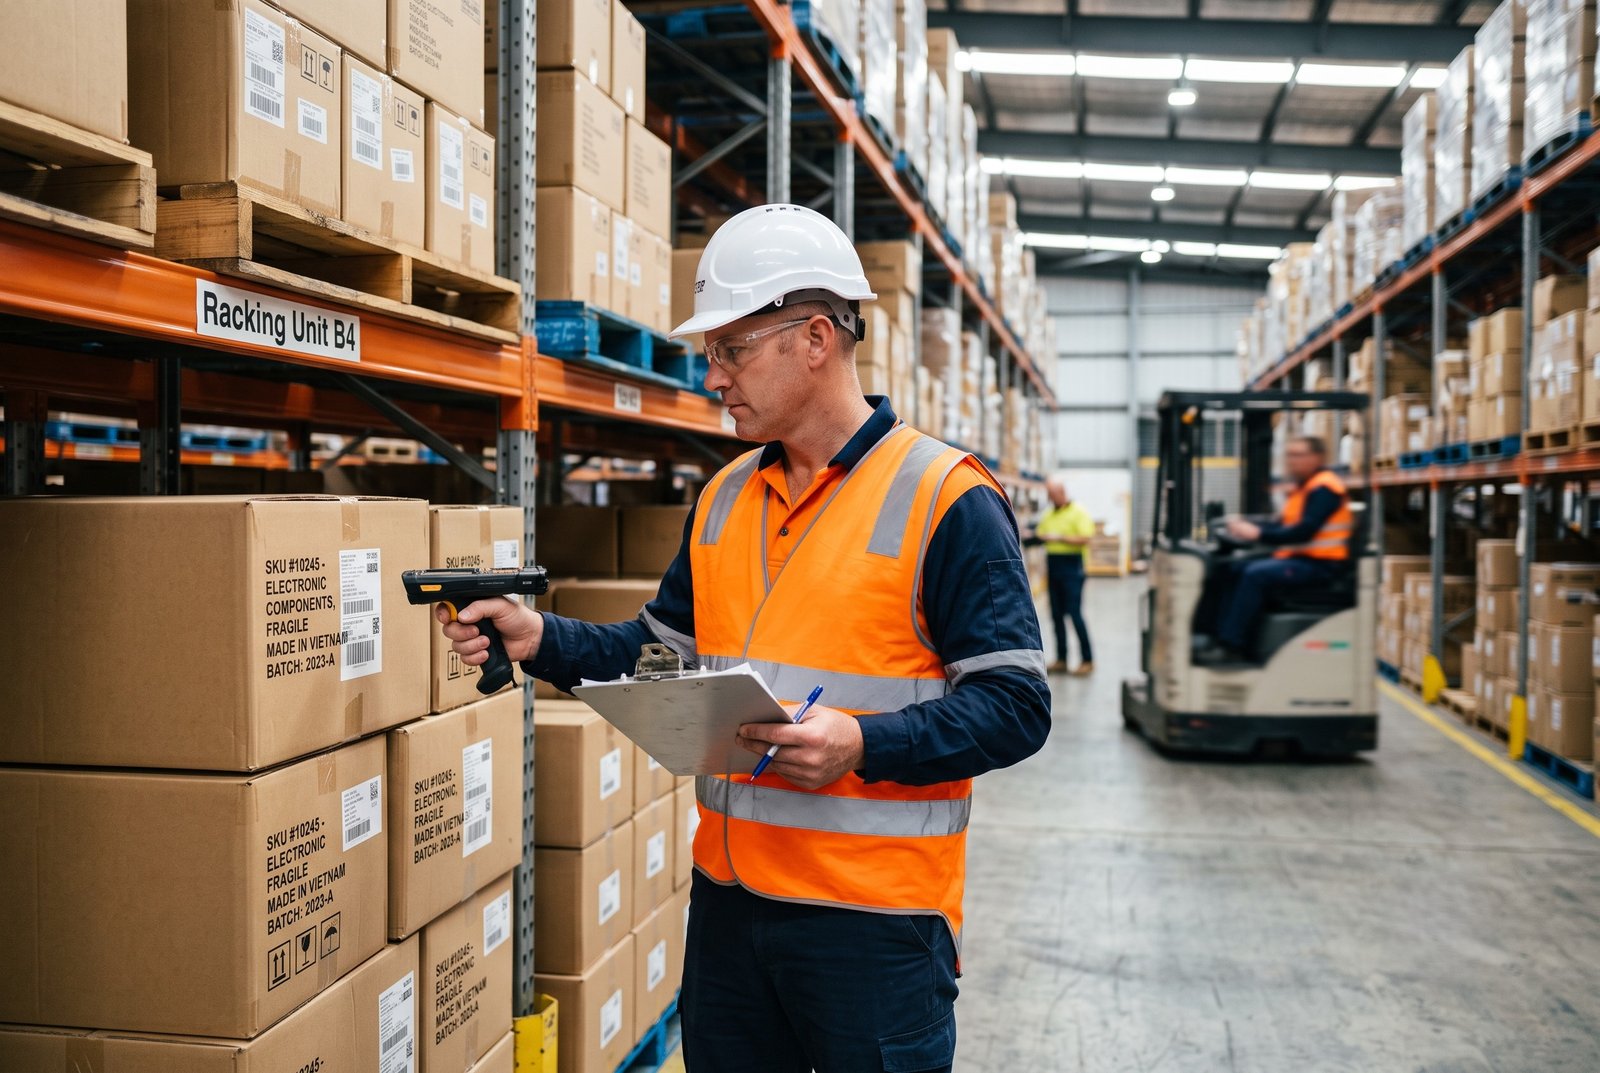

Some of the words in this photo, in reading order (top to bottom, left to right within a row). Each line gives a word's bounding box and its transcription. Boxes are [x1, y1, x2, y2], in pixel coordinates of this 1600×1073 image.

[204, 290, 286, 346] Racking
[292, 310, 329, 347] Unit
[334, 319, 356, 351] B4
[265, 559, 287, 575] SKU
[289, 557, 320, 573] #10245
[446, 556, 459, 569] SKU
[266, 576, 327, 596] ELECTRONIC
[266, 595, 336, 616] COMPONENTS,
[266, 618, 309, 637] FRAGILE
[266, 640, 295, 658] MADE
[298, 638, 307, 653] IN
[267, 659, 303, 679] BATCH:
[306, 652, 335, 671] 2023-A
[414, 778, 429, 795] SKU
[414, 784, 458, 813] ELECTRONIC,
[414, 805, 444, 829] FRAGILE
[414, 827, 434, 847] MADE
[435, 822, 442, 838] IN
[444, 812, 465, 833] VIETNA
[267, 829, 287, 851] SKU
[289, 817, 320, 843] #10245
[414, 842, 439, 864] BATCH:
[440, 831, 461, 852] 2023-A
[267, 834, 326, 873] ELECTRONIC
[267, 862, 308, 894] FRAGILE
[267, 888, 296, 915] MADE
[297, 882, 307, 900] IN
[309, 862, 346, 893] VIETNAM
[267, 906, 303, 936] BATCH:
[305, 889, 334, 916] 2023-A
[435, 958, 450, 977] SKU
[435, 956, 475, 995] ELECTRONIC
[435, 980, 463, 1012] FRAGILE
[435, 1003, 455, 1029] MADE
[455, 997, 462, 1013] IN
[462, 976, 487, 1006] VIETNAM
[435, 1021, 460, 1046] BATCH:
